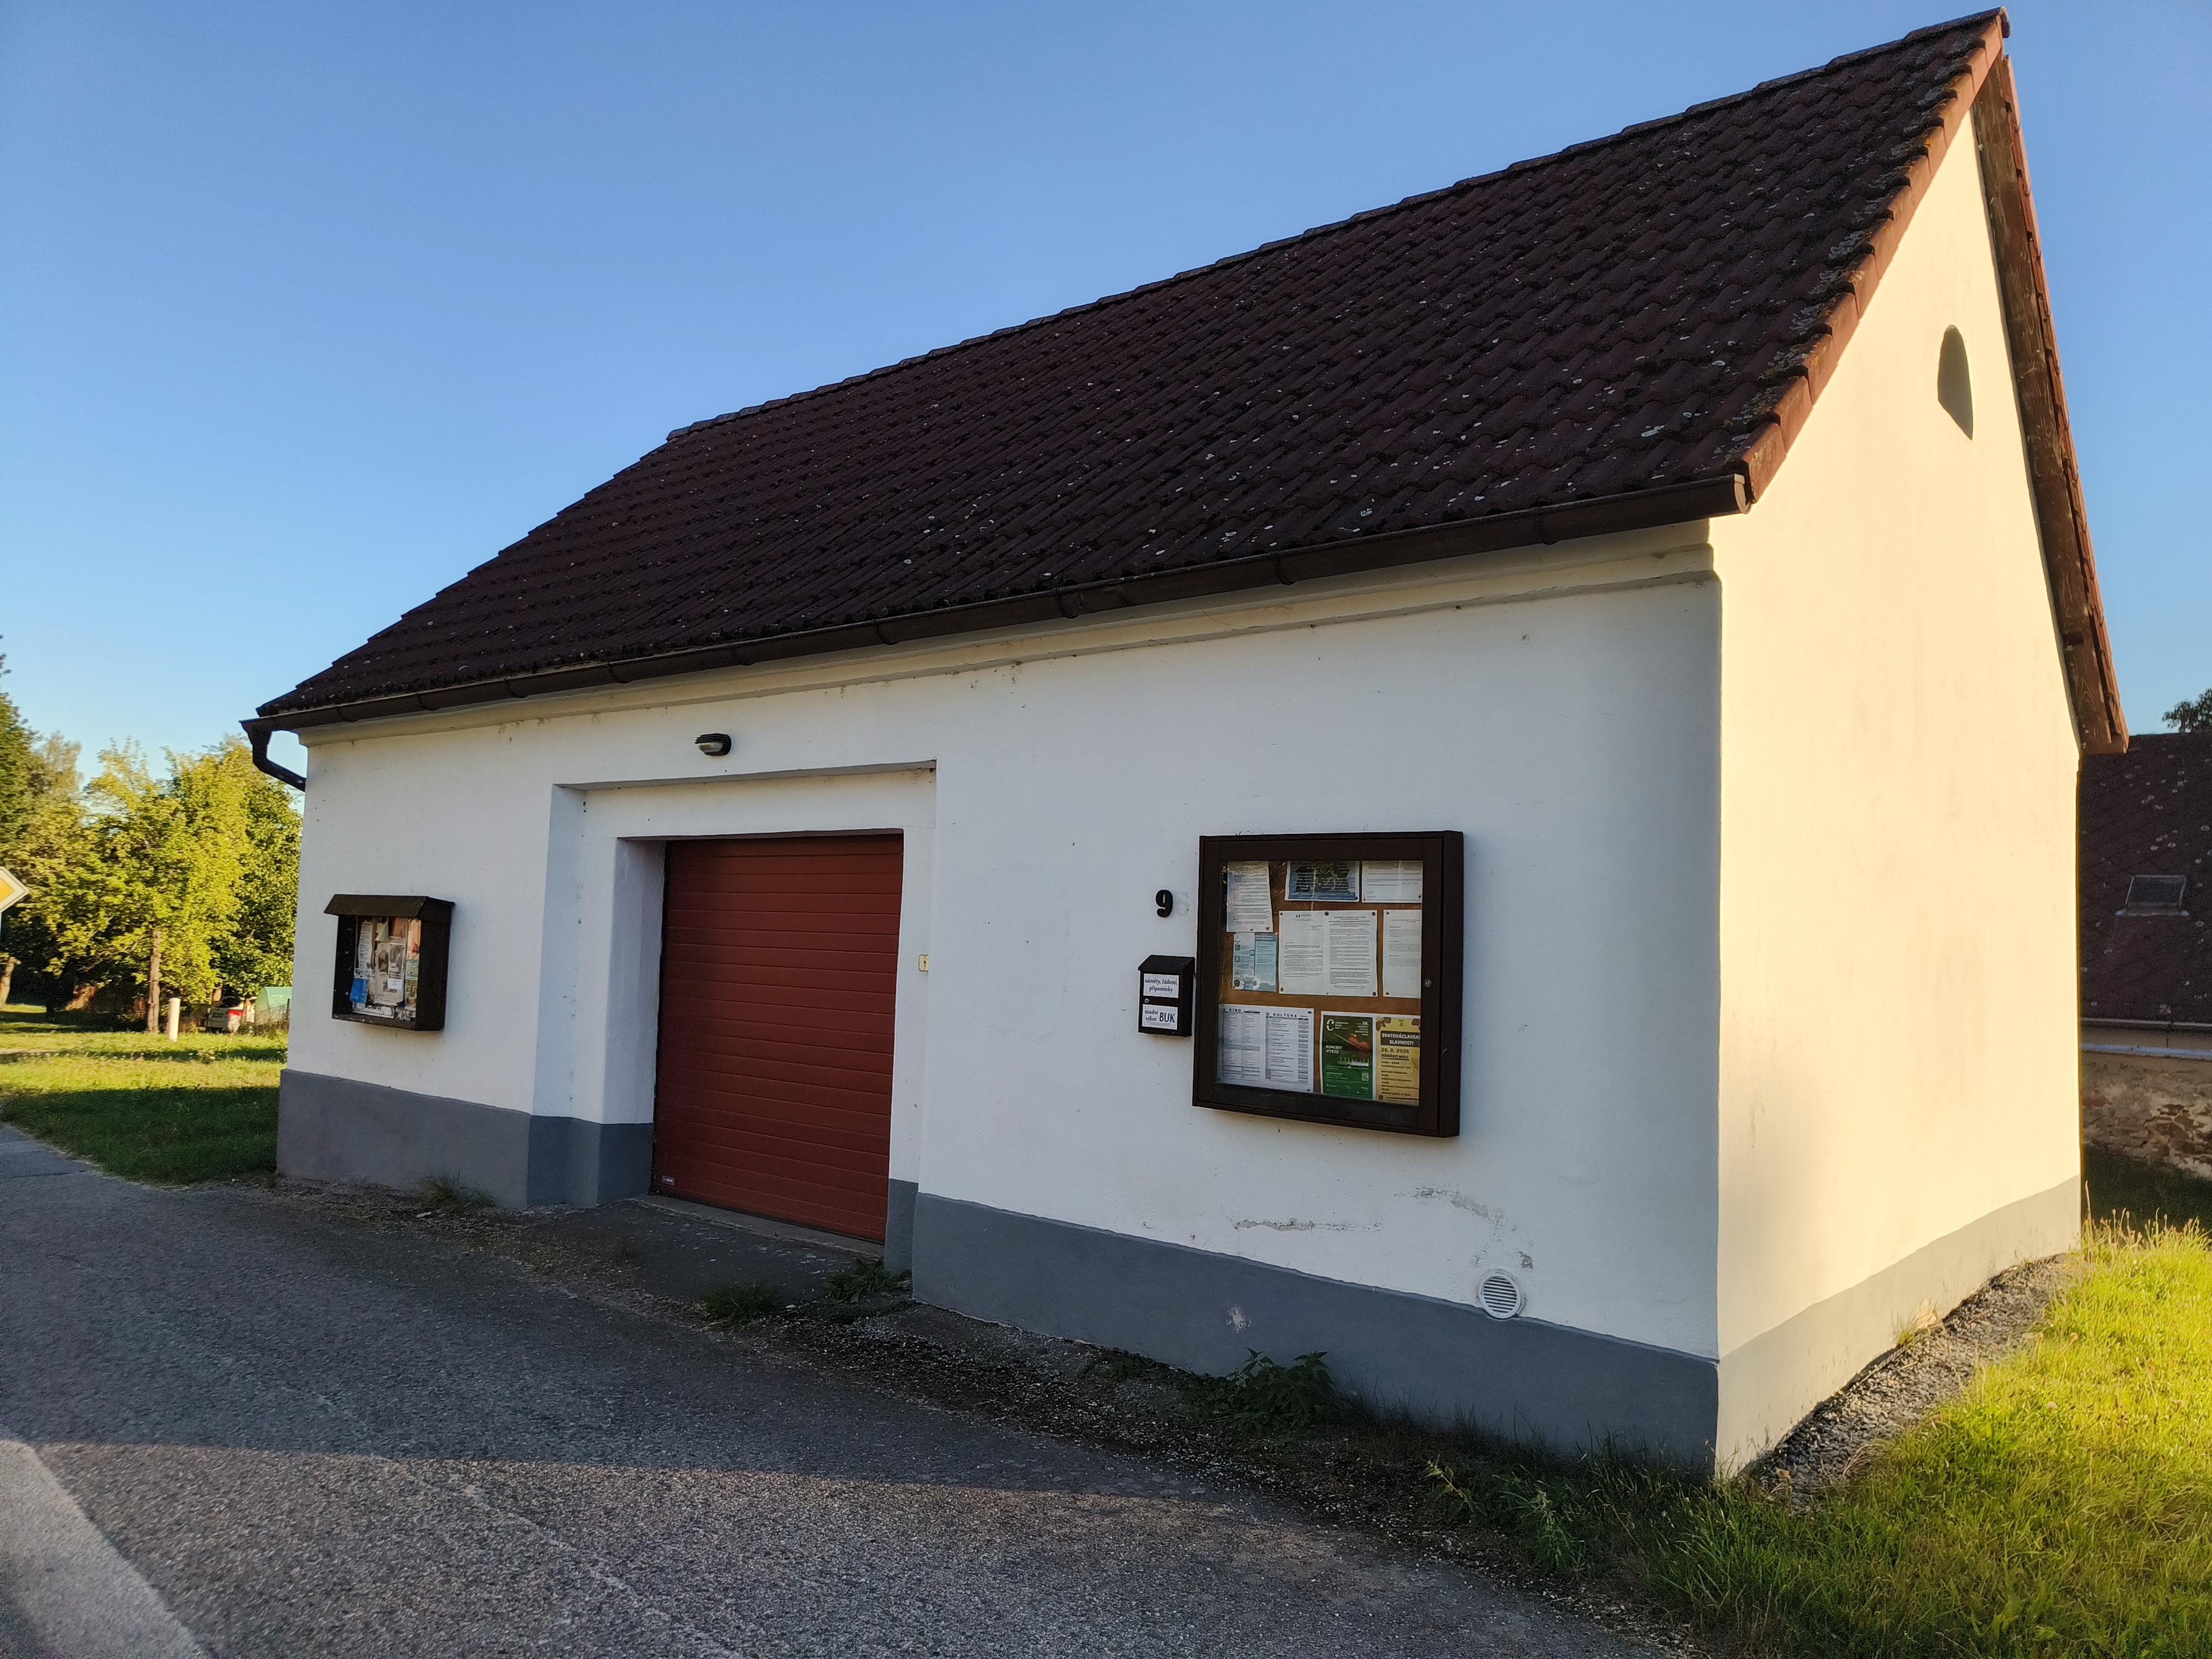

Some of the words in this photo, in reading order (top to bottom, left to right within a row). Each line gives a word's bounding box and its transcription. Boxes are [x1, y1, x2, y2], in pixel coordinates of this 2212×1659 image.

[1156, 889, 1173, 918] 9
[1149, 985, 1173, 994] připomínky
[1159, 1013, 1175, 1023] BUK
